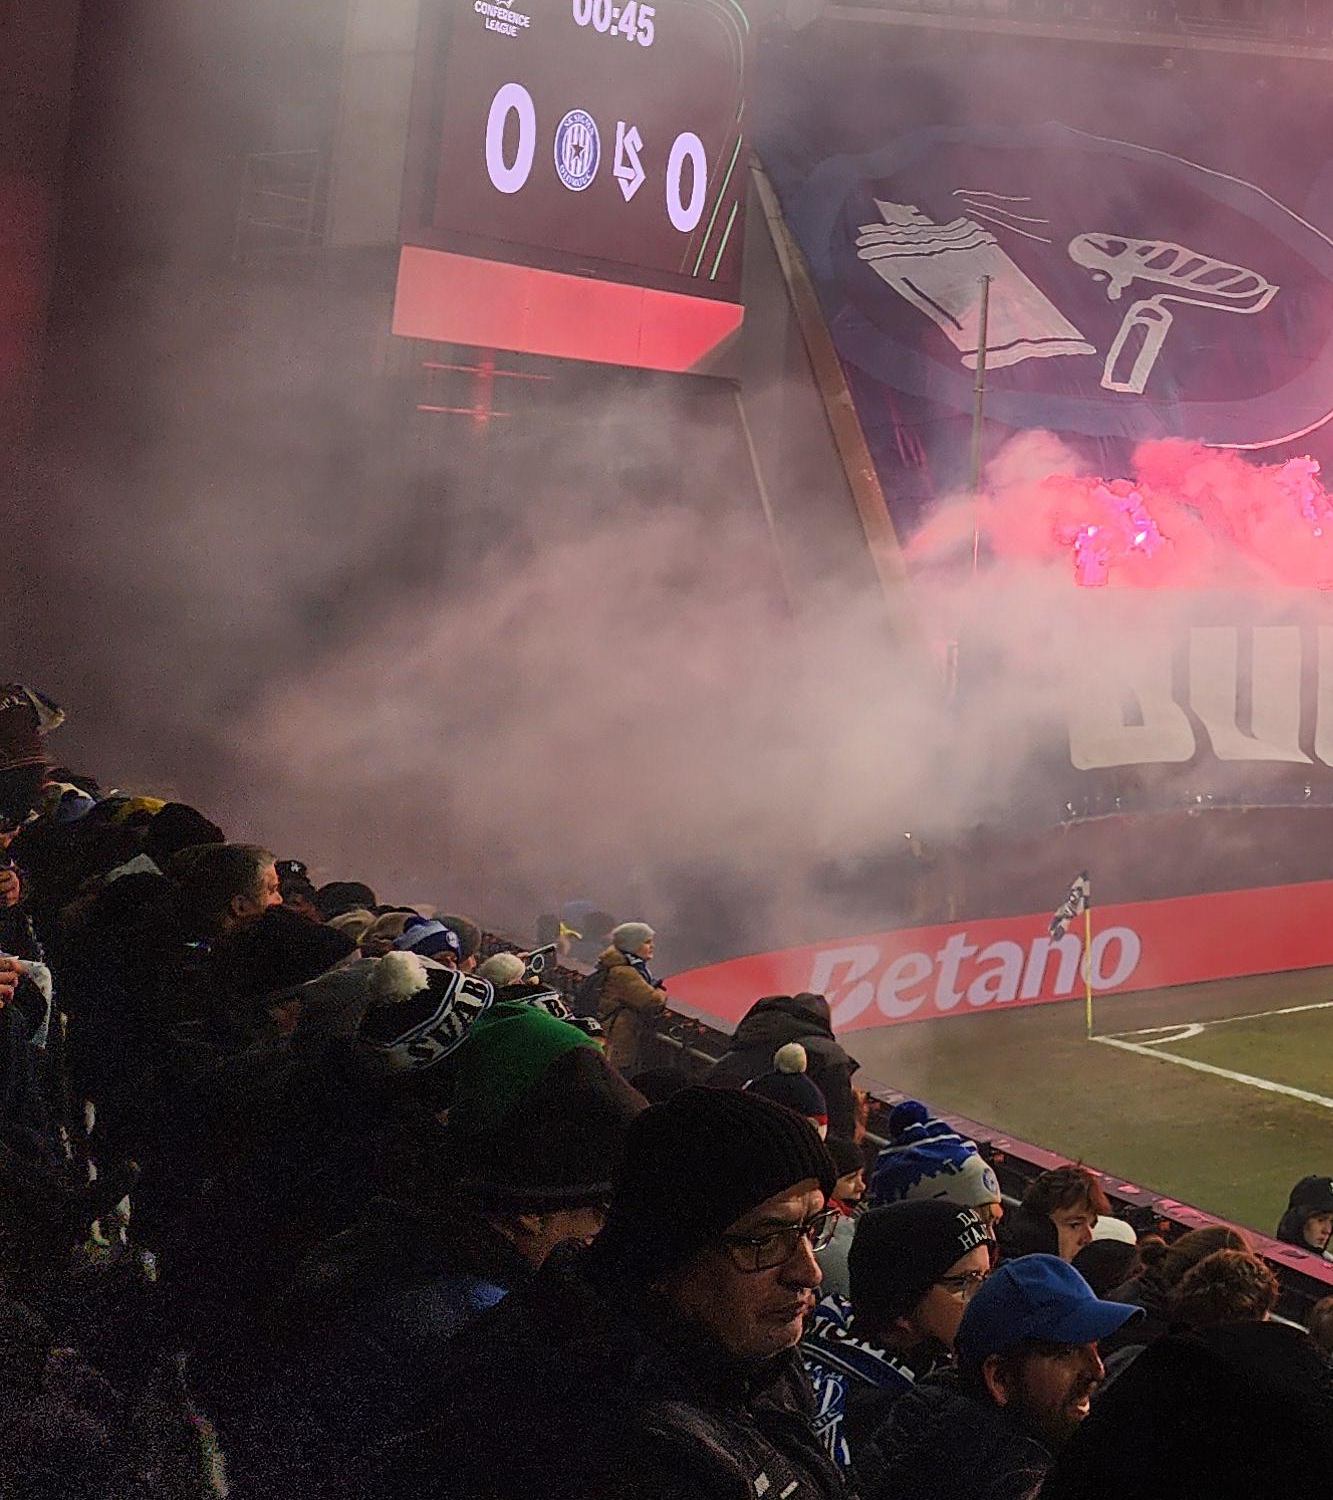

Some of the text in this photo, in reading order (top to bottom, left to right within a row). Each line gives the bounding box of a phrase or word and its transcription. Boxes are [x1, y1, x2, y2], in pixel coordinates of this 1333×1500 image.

[474, 0, 531, 28] CONFERENCE
[485, 17, 518, 37] LEAGUE
[486, 82, 536, 193] 0
[666, 131, 707, 232] 0
[804, 926, 1141, 1031] Betano
